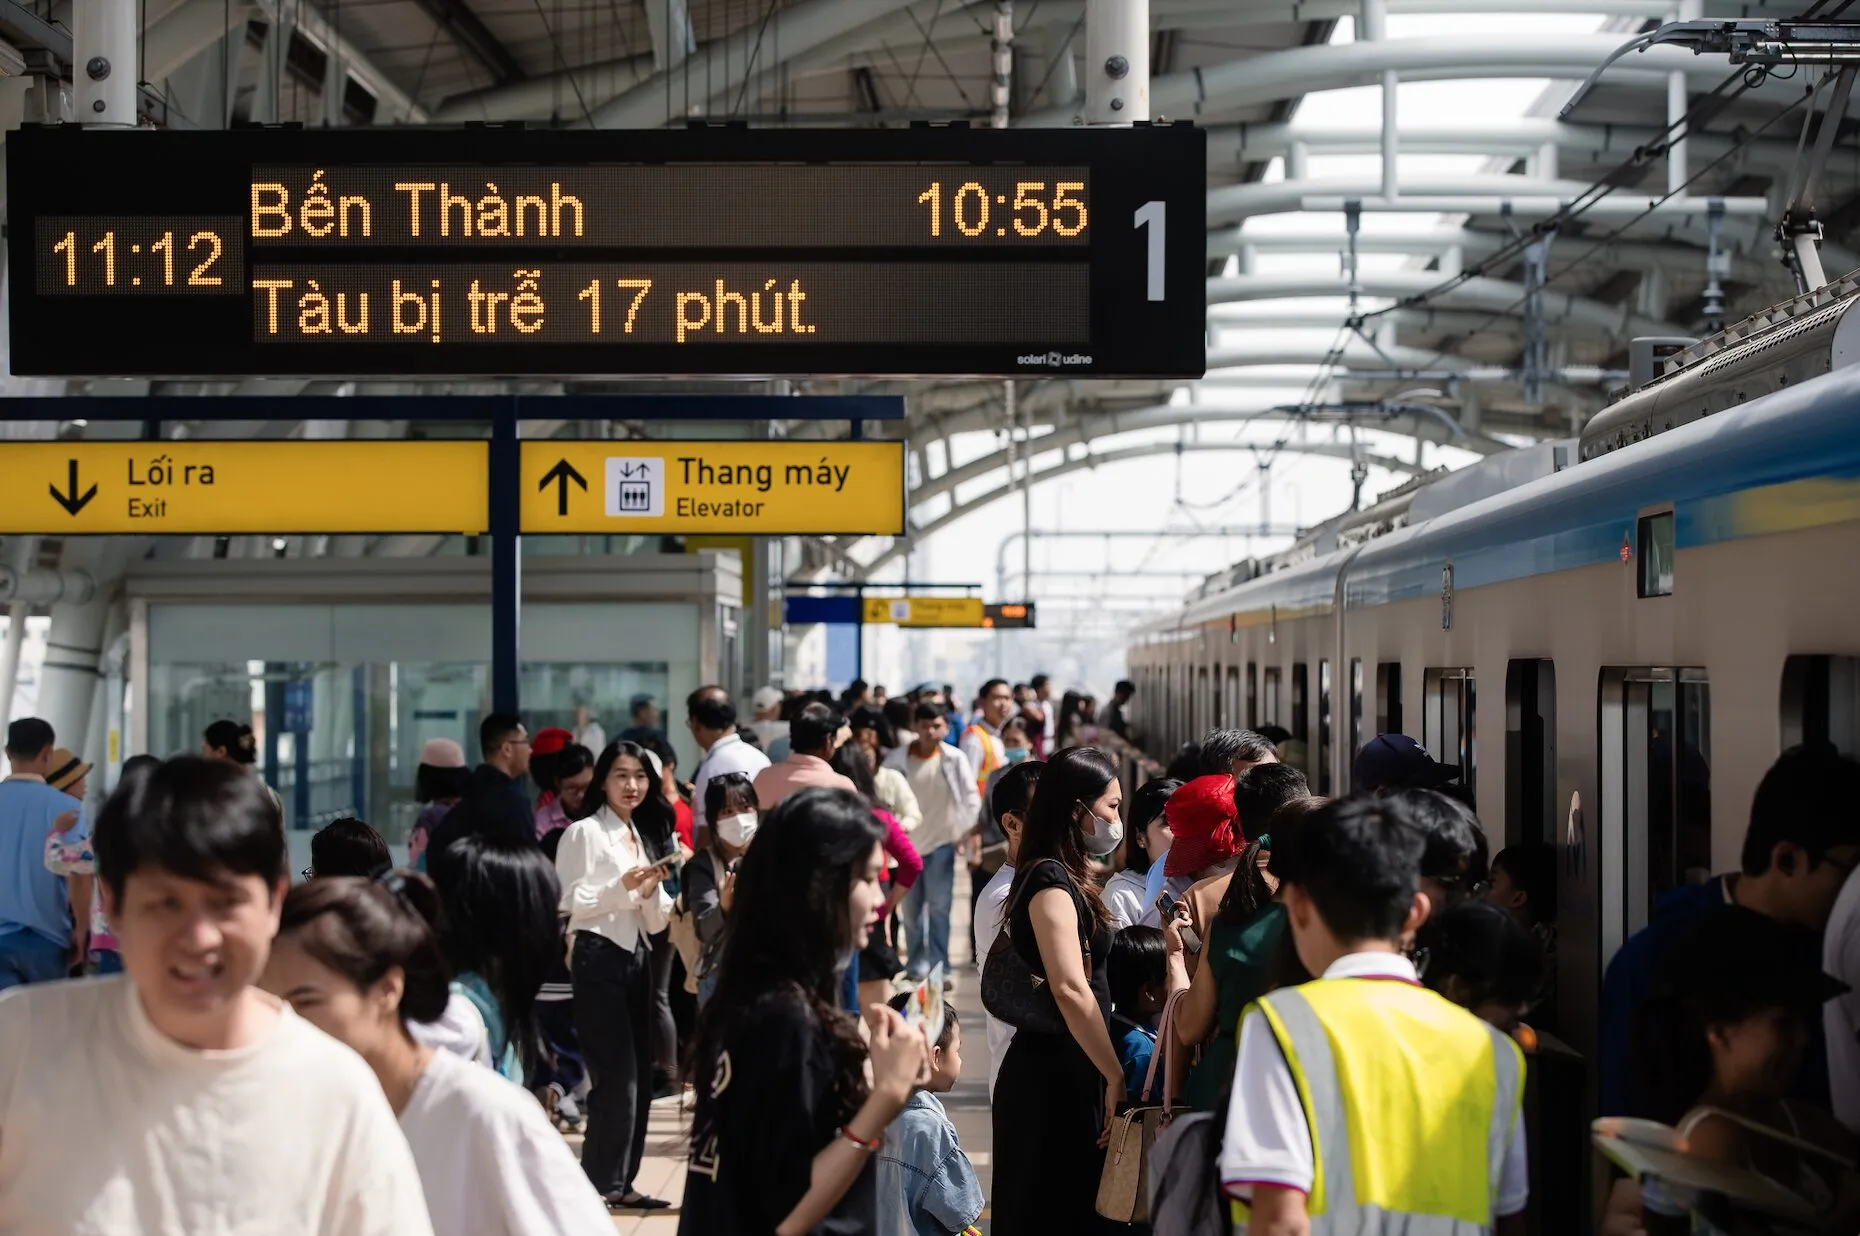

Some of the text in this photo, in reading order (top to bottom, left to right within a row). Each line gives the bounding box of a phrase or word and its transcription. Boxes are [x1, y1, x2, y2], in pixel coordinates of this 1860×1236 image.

[250, 169, 584, 237] Bến Thành
[918, 181, 1088, 237] 10:55
[53, 231, 222, 286] 11:12
[1134, 200, 1165, 301] 1
[252, 269, 816, 343] Tàu bị trễ 17 phút.
[1017, 354, 1093, 365] solari udine
[127, 454, 215, 486] Lối ra
[677, 457, 851, 493] Thang máy
[128, 498, 167, 518] Exit
[677, 497, 765, 518] Elevator
